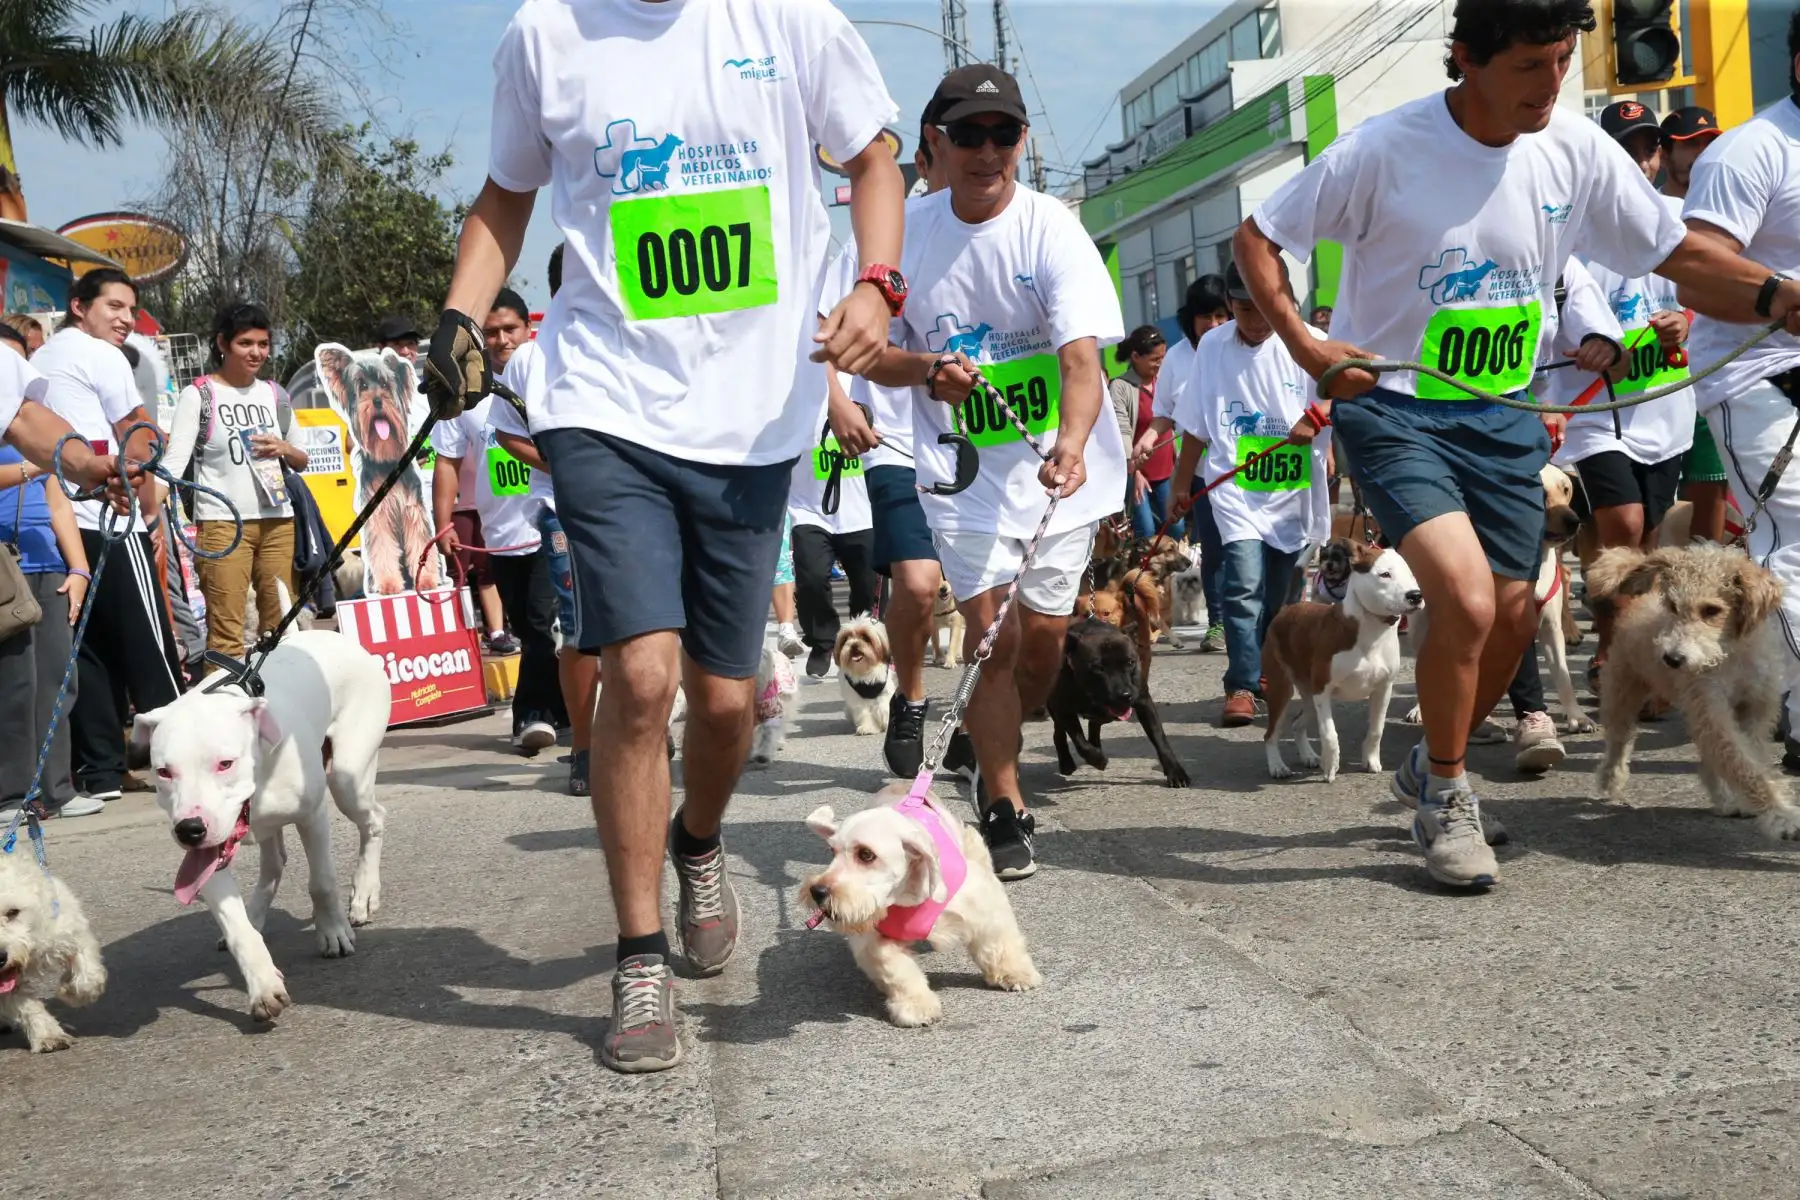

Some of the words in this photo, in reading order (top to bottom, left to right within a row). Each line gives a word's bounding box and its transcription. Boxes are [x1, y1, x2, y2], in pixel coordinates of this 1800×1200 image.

[740, 67, 776, 81] migue
[678, 141, 758, 160] HOSPITALES
[681, 166, 773, 186] VETERINARIOS
[637, 222, 752, 299] 0007
[1437, 319, 1530, 378] 0006
[218, 403, 275, 428] GOOD
[965, 376, 1049, 435] 0059
[1244, 451, 1303, 483] 0053
